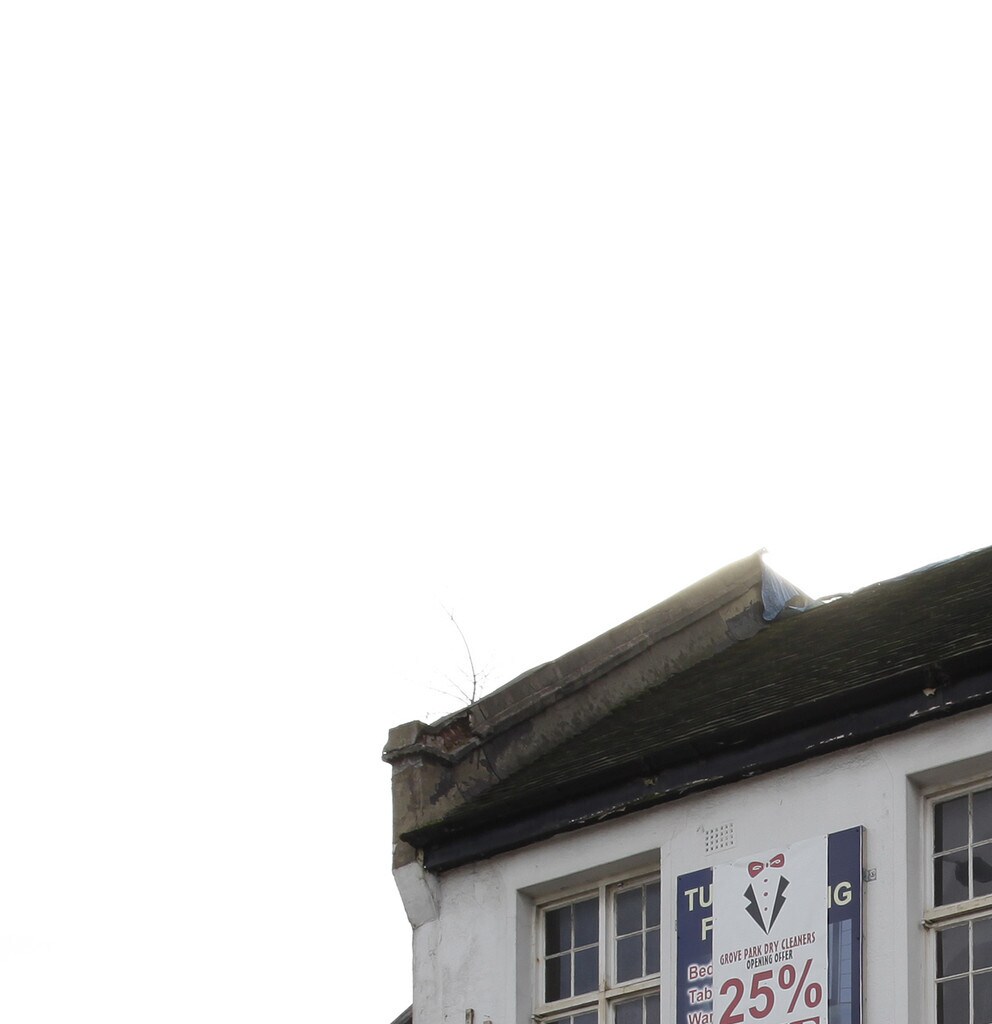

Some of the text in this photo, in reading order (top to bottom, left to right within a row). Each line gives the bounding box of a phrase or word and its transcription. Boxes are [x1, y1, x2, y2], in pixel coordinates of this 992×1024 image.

[720, 931, 816, 965] GROVE PARK DRY CLEANERS
[746, 949, 793, 969] OPENING OFFER
